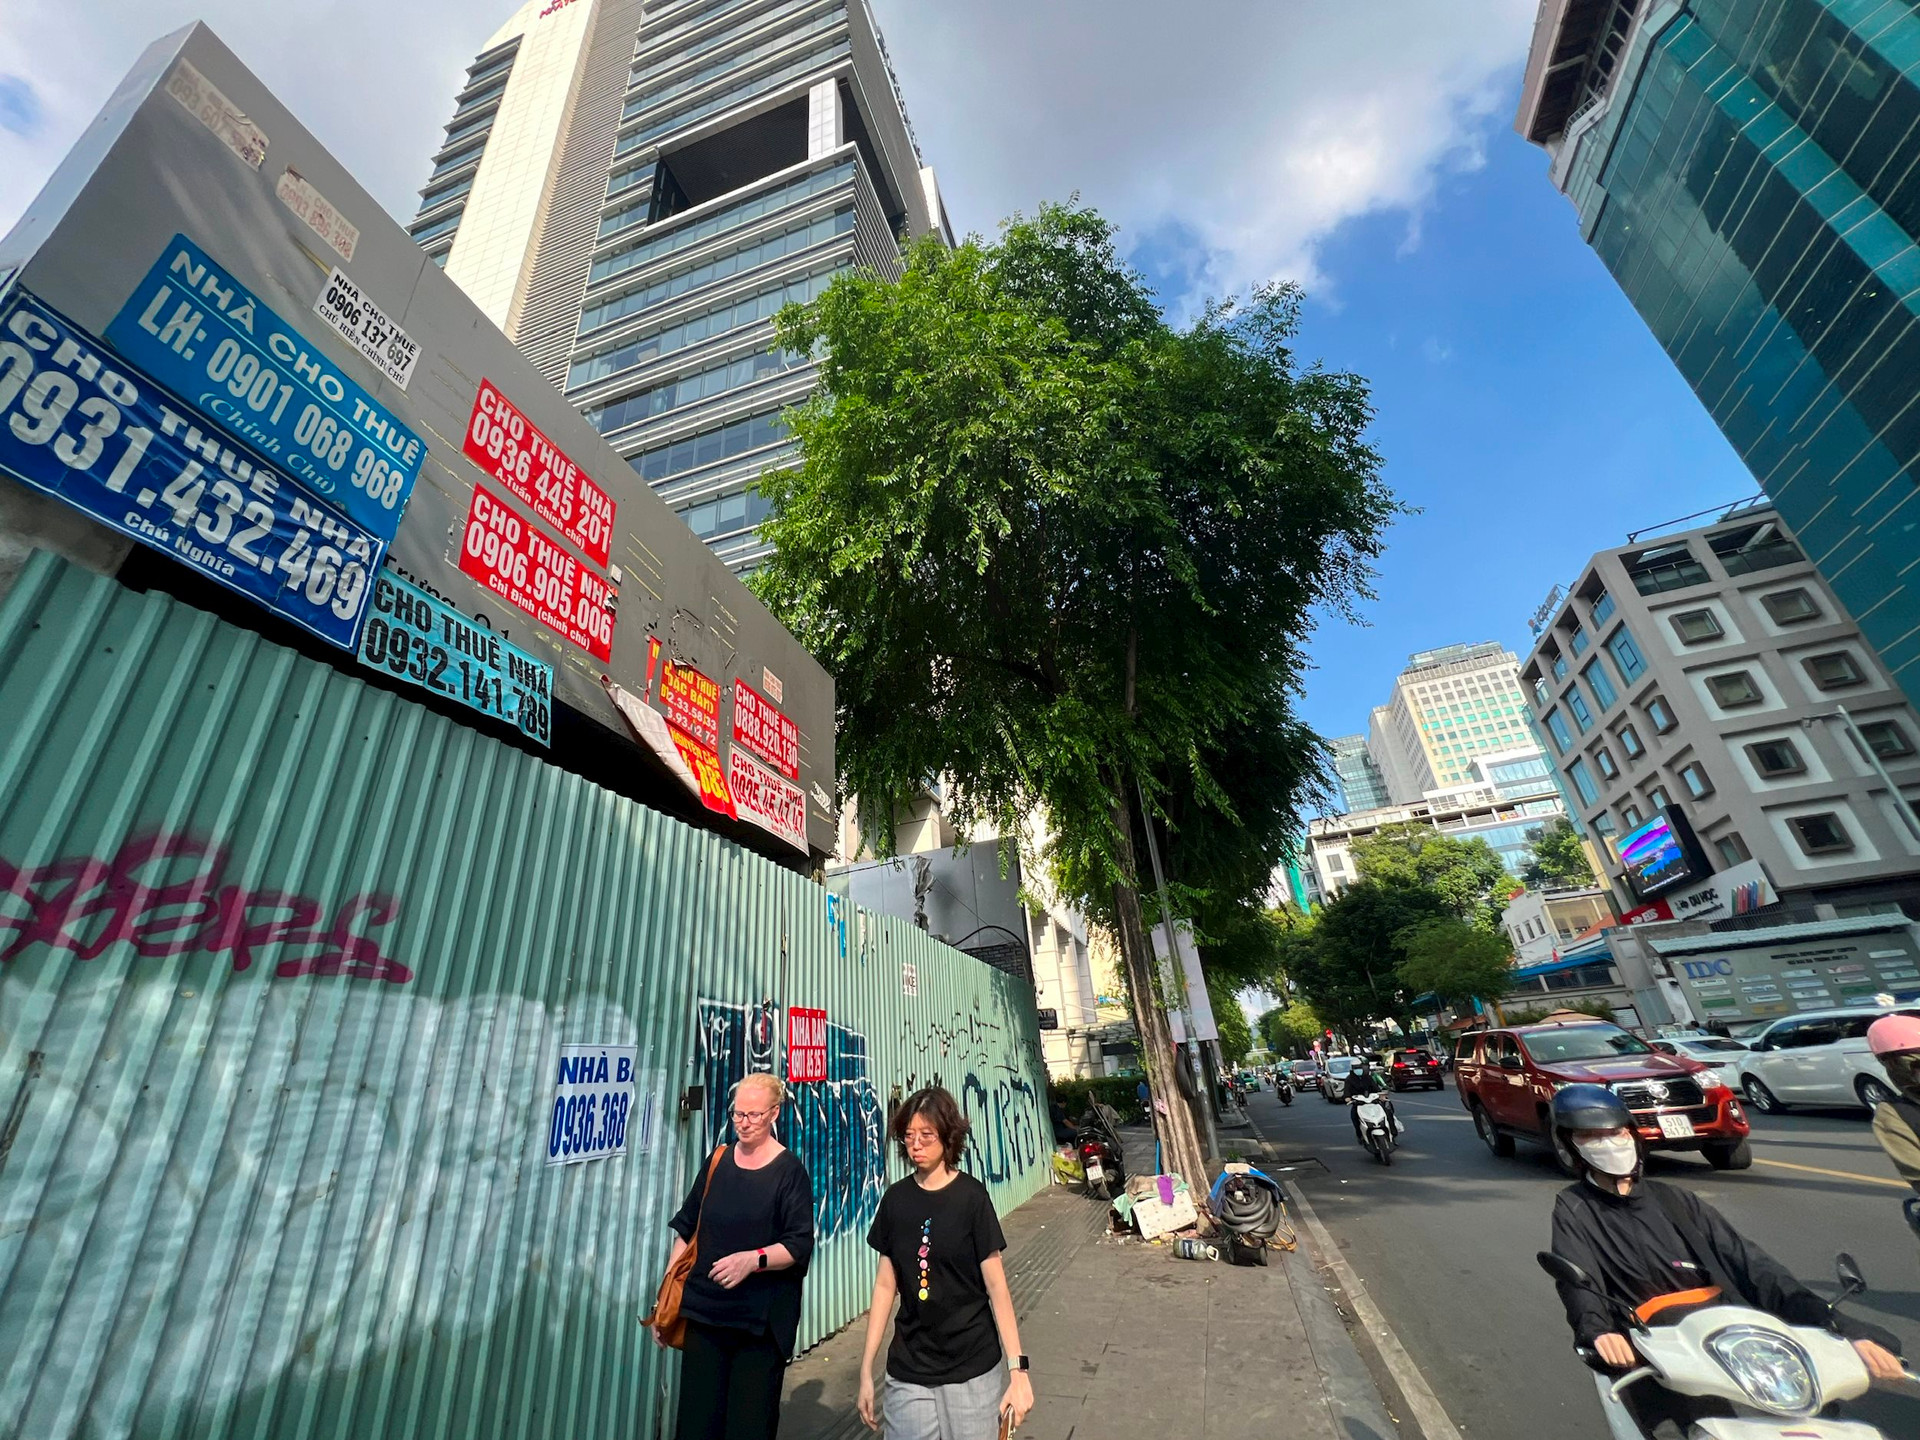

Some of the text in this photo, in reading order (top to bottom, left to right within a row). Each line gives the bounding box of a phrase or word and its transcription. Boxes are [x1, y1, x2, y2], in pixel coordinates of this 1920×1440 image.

[326, 286, 412, 371] 0906 137 697
[334, 274, 417, 357] NHÀ CHO THUÊ
[137, 285, 404, 510] LH: 0901 068 968
[169, 250, 420, 468] NHÀ CHO THUÊ
[8, 309, 371, 567] CHO THUÊ NHÀ
[199, 392, 282, 455] (Chính
[480, 387, 612, 519] CHO THUÊ NHÀ
[0, 341, 367, 621] 0931.432.469
[472, 412, 611, 554] 0936 445 201
[533, 496, 564, 532] (chính
[124, 511, 236, 578] Chú Nghĩa
[474, 494, 521, 544] CHO
[527, 529, 576, 587] THUÊ
[466, 521, 612, 645] 0906.905.006
[537, 604, 568, 634] (chính
[365, 617, 550, 742] 0932.141.789
[374, 578, 432, 633] CHO
[440, 613, 502, 672] THUÊ
[507, 651, 550, 700] NHÀ
[735, 683, 756, 713] CHO
[757, 700, 780, 732] THUÊ
[781, 719, 798, 746] NHÀ
[735, 703, 798, 769] 0888.920.130
[732, 753, 755, 778] CHO
[757, 769, 783, 796] THUÊ
[1682, 958, 1734, 979] IDC
[557, 1051, 609, 1085] NHÀ
[791, 1009, 811, 1047] NHÀ
[811, 1011, 827, 1047] BÁN
[549, 1091, 629, 1158] 0936.368
